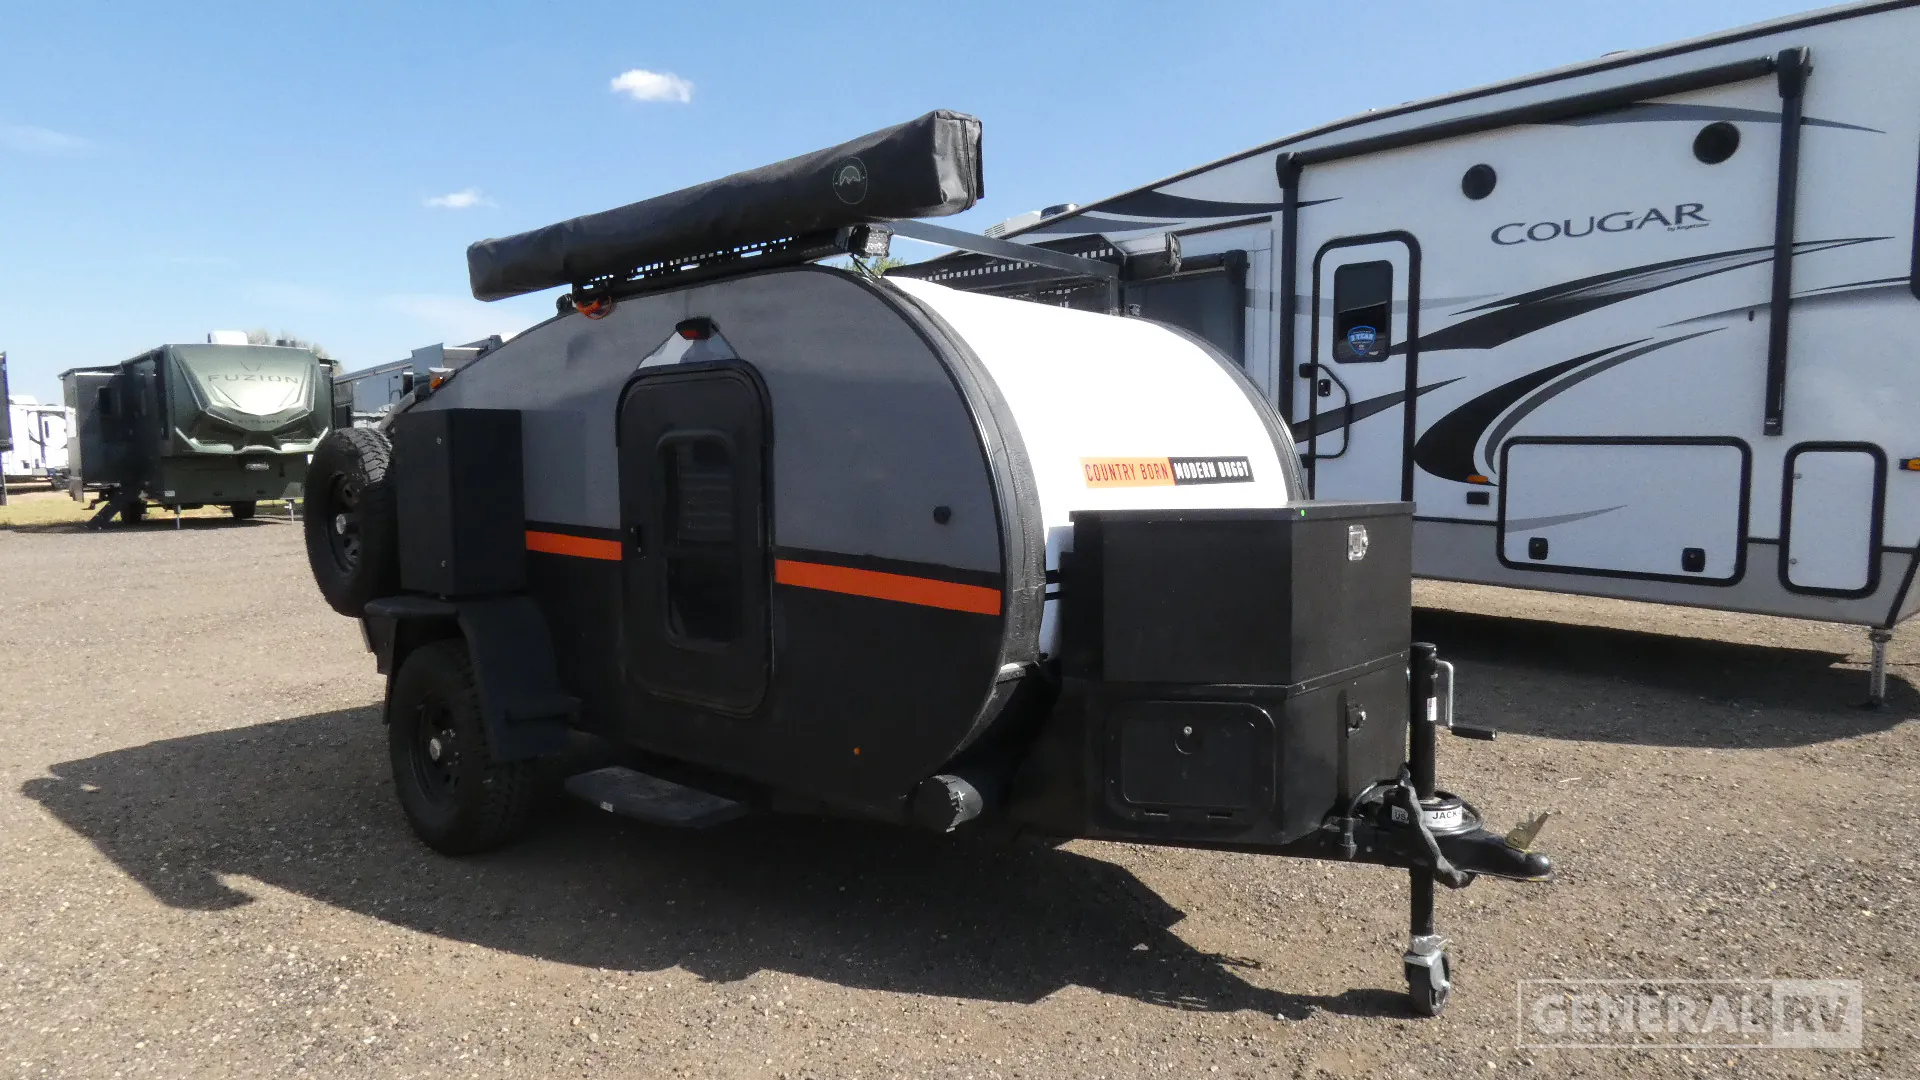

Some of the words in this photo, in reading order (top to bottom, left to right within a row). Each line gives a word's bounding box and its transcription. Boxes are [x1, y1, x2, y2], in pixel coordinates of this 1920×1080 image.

[1491, 203, 1711, 245] COUGAR
[207, 373, 299, 384] FUZION
[1085, 463, 1135, 481] COUNTRY
[1139, 462, 1169, 480] BORN
[1173, 462, 1217, 479] MODERN
[1218, 460, 1250, 478] BUGGY
[1432, 811, 1458, 820] JACK
